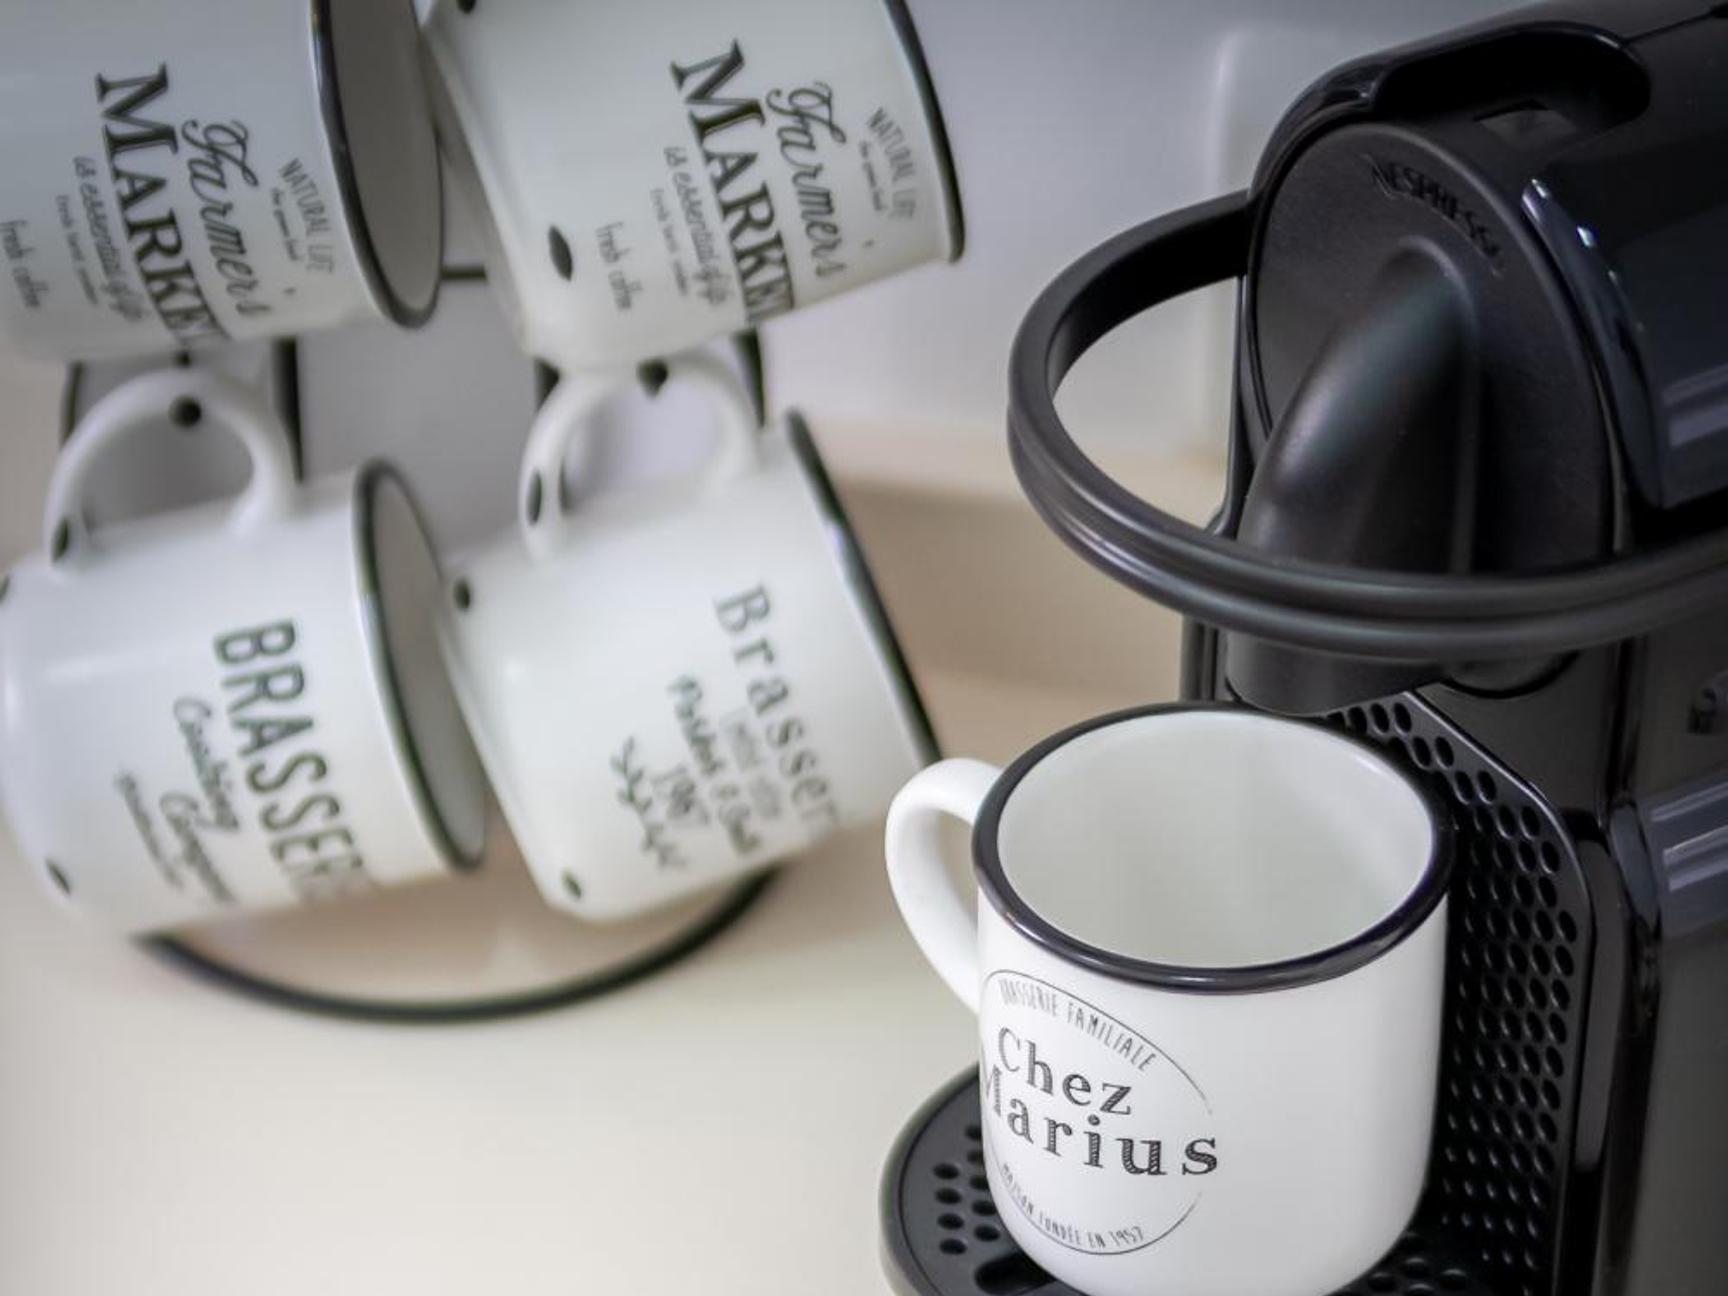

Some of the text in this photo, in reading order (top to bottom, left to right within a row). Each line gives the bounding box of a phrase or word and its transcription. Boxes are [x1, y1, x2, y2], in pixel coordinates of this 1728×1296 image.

[998, 1026, 1132, 1116] Chez
[1067, 1002, 1157, 1073] FAMILIALE
[1088, 1231, 1107, 1249] EN
[1108, 1225, 1145, 1246] 1957
